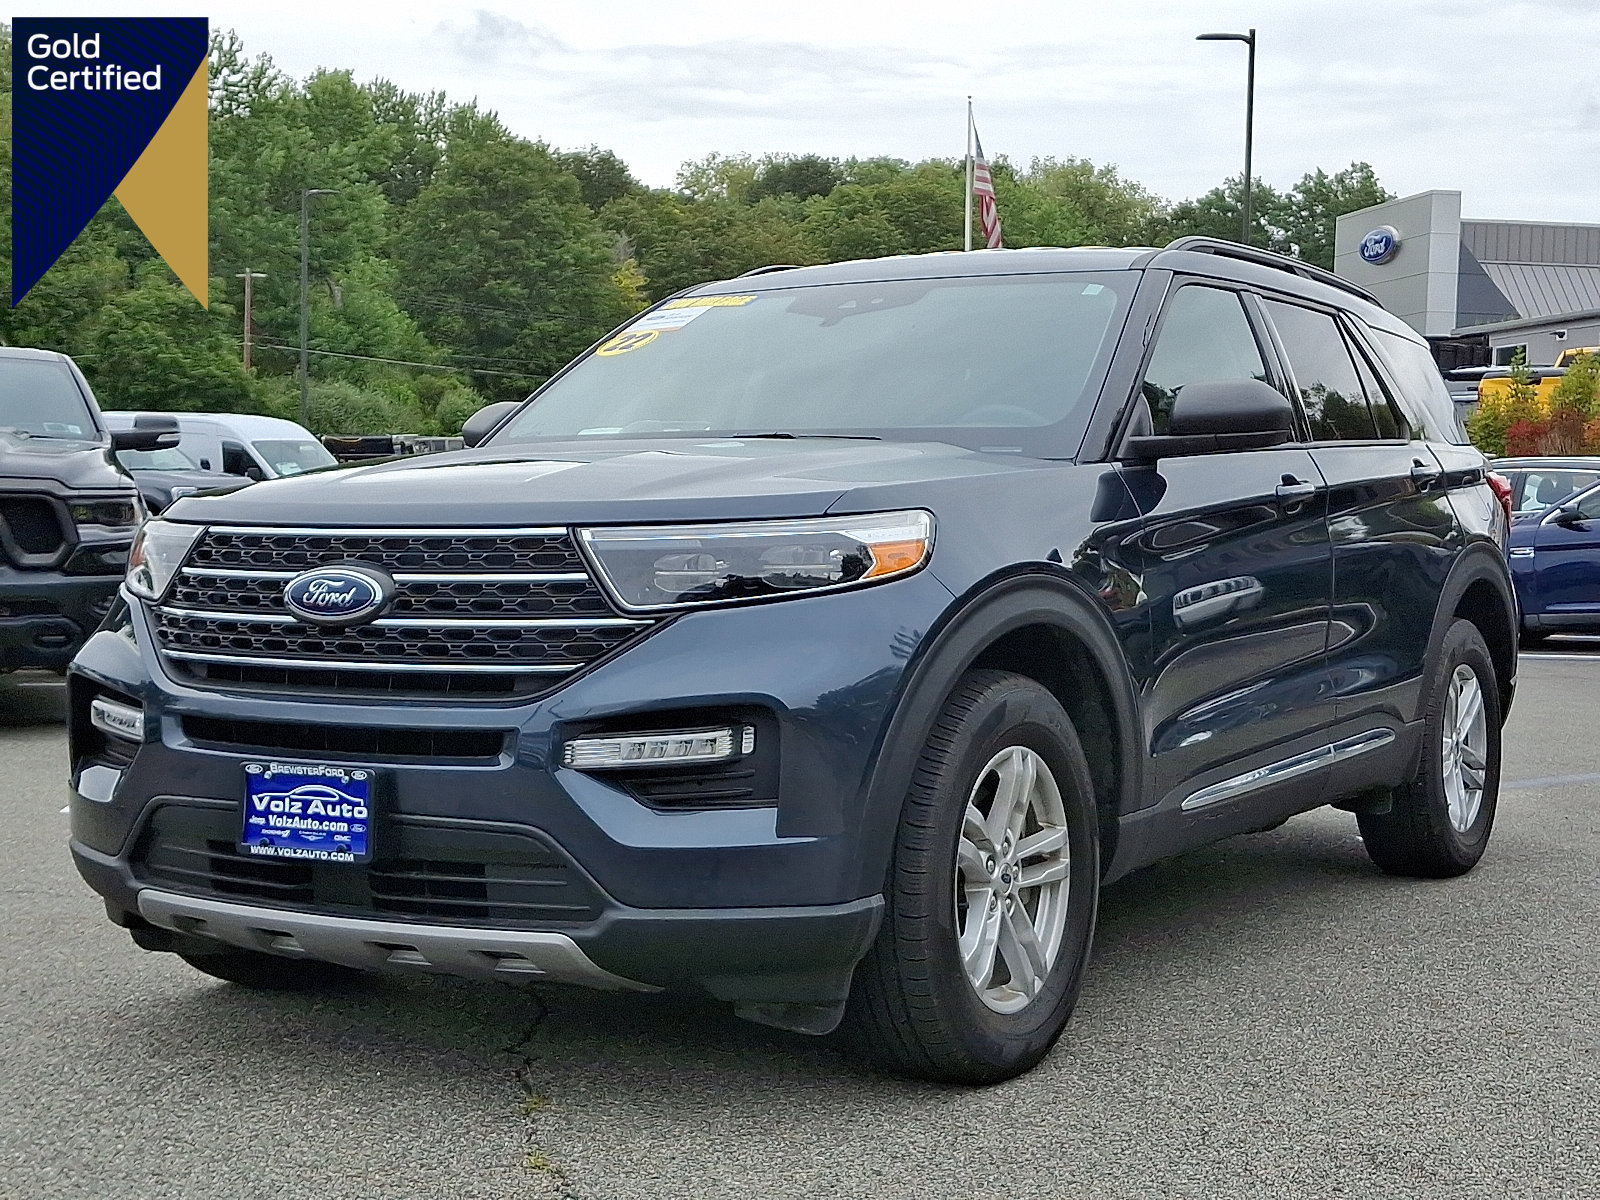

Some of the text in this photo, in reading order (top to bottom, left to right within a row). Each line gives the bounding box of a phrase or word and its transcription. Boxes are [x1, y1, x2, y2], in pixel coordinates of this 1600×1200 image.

[1363, 234, 1387, 257] Ford
[603, 333, 653, 353] 22
[302, 579, 357, 607] Ford
[252, 794, 368, 819] Volz Auto
[268, 814, 348, 832] VolzAuto.com
